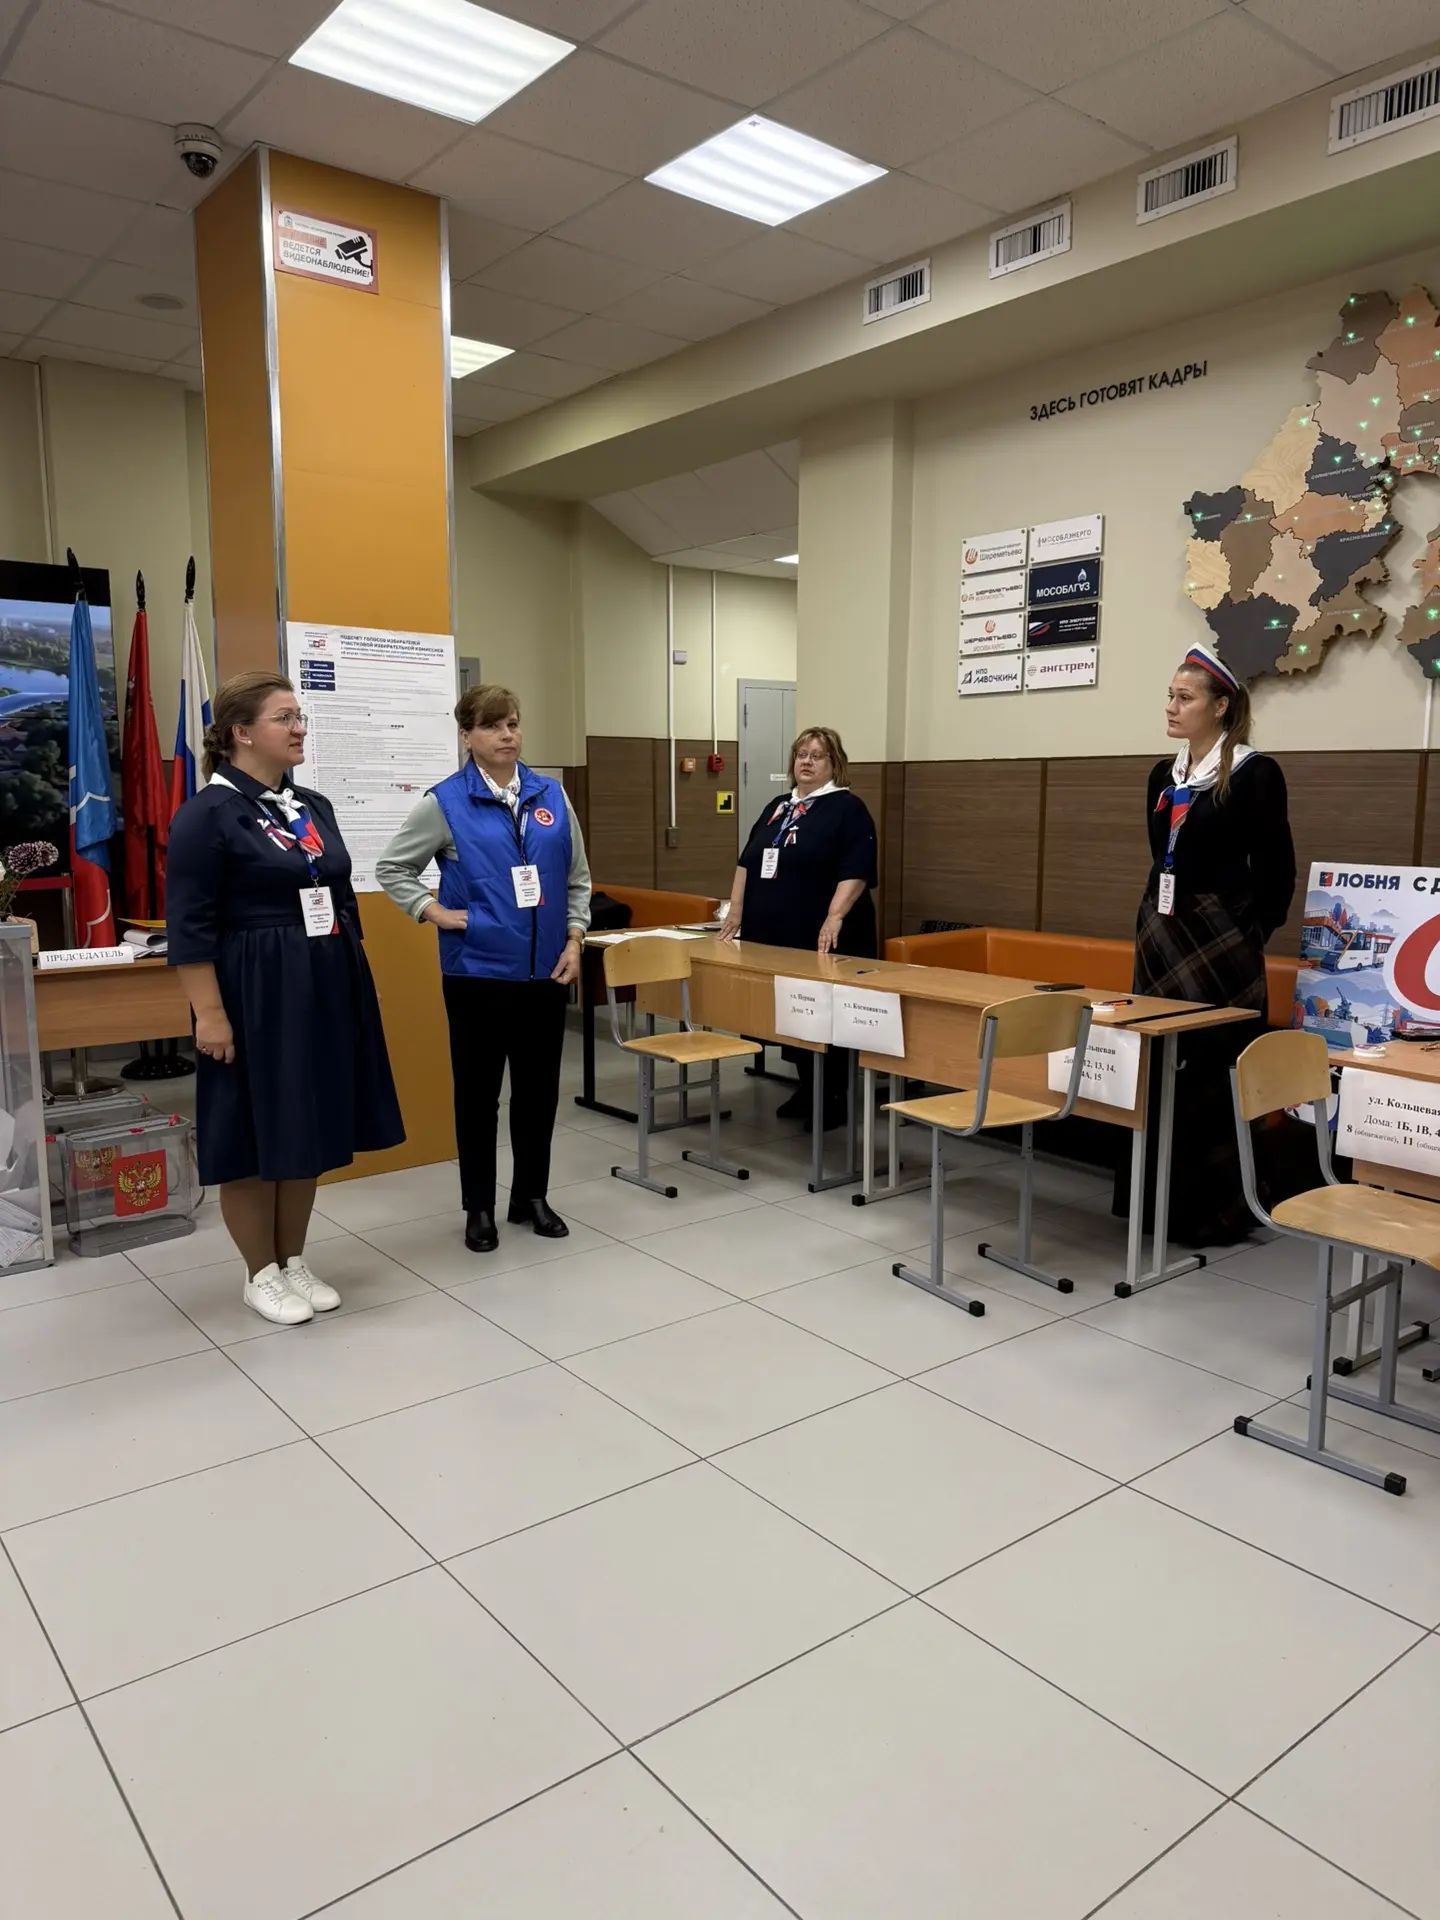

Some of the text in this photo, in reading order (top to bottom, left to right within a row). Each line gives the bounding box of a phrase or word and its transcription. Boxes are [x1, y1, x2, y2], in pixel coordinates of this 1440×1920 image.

[283, 241, 321, 256] ВЕДЕТСЯ
[283, 251, 370, 278] ВИДЕОНАБЛЮДЕНИЕ!
[1030, 360, 1207, 421] ЗДЕСЬ ГОТОВЯТ КАДРЫ
[1041, 529, 1092, 544] МОСОБЛЭНЕРГО
[979, 548, 1023, 561] Шереметьево
[1036, 582, 1090, 598] МОСОБЛГАЗ
[1040, 661, 1095, 673] ангстрем
[973, 673, 1018, 684] ЛАВОЧКИНА
[1335, 873, 1401, 891] ЛОБНЯ
[46, 950, 124, 962] ПРЕДСЕДАТЕЛЬ
[1087, 1045, 1116, 1055] льцевая
[1095, 1062, 1105, 1071] 13,
[1106, 1064, 1117, 1073] 14,
[1094, 1073, 1102, 1081] 15
[1368, 1096, 1384, 1106] ул.
[1364, 1114, 1393, 1129] Дома:
[1396, 1120, 1413, 1133] 1Б,
[1416, 1124, 1432, 1137] 1В,
[1346, 1124, 1353, 1133] 8
[1403, 1136, 1413, 1146] 11
